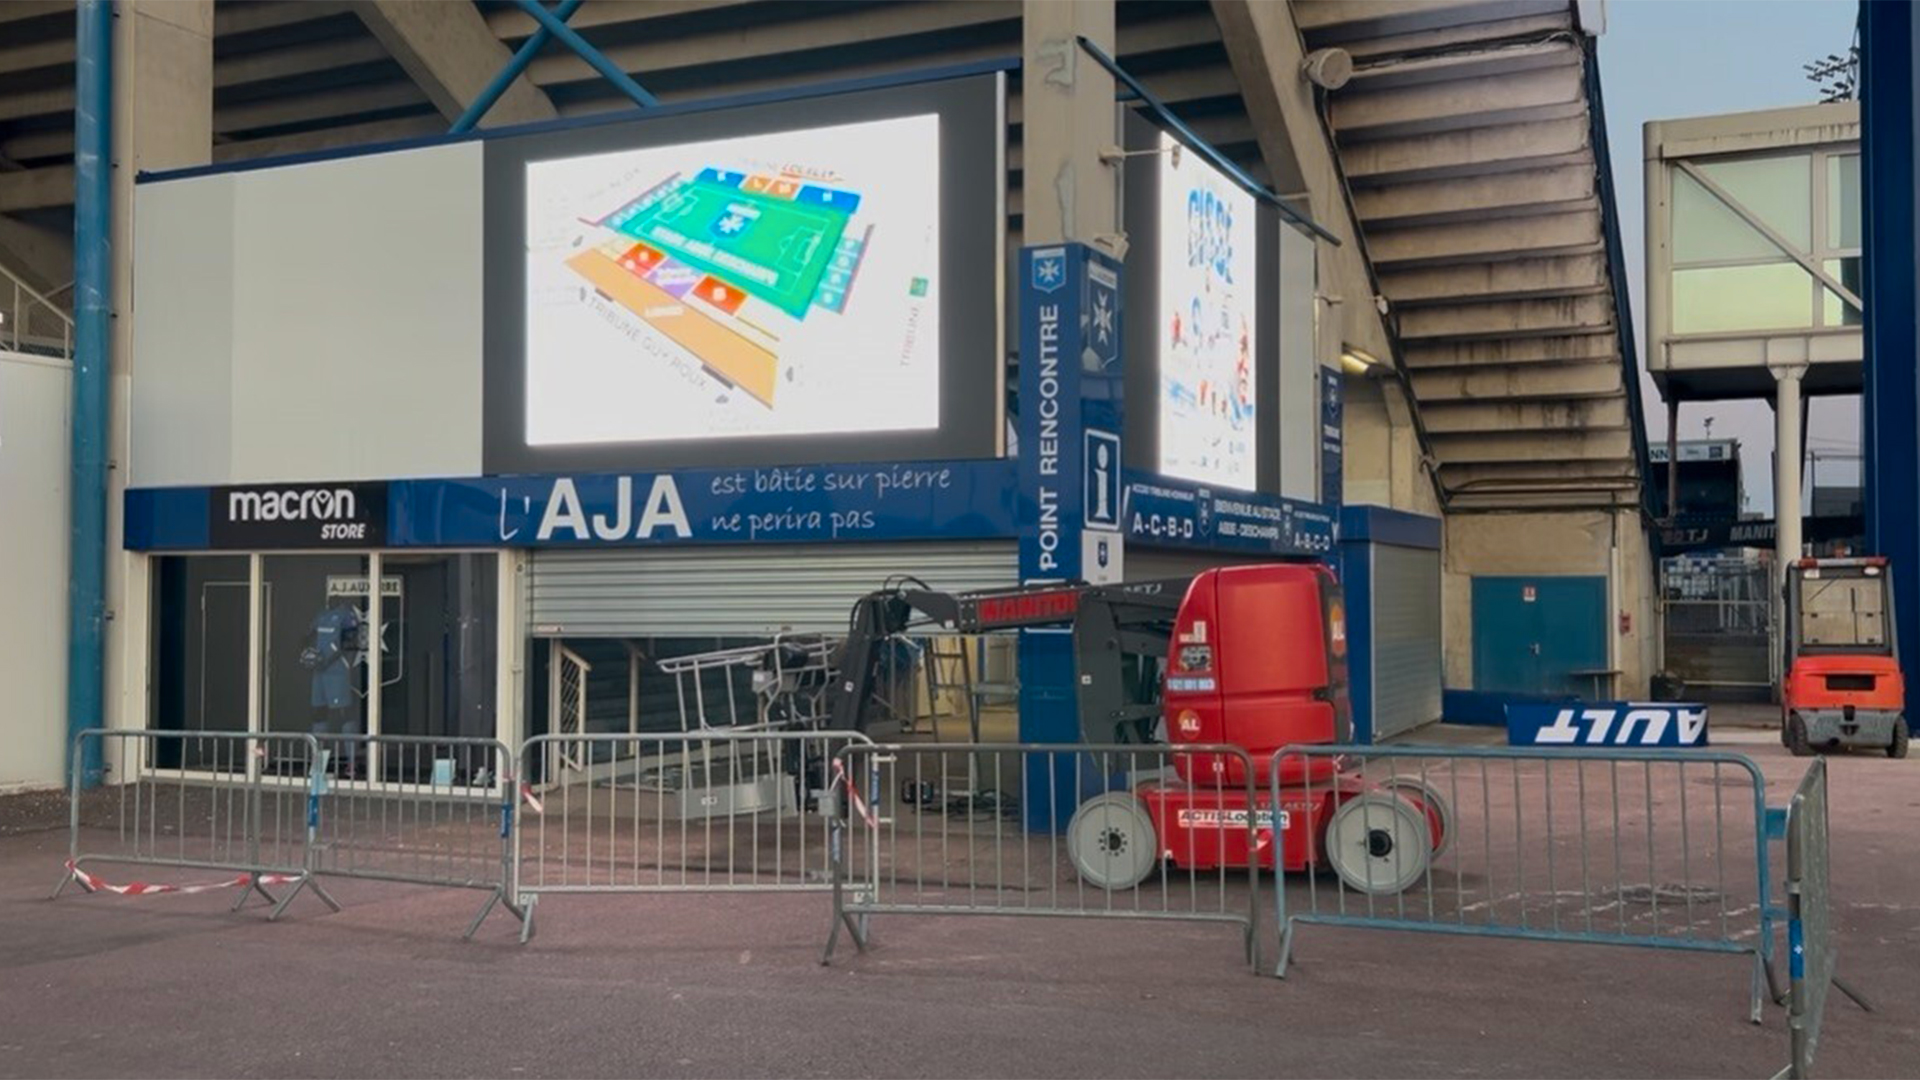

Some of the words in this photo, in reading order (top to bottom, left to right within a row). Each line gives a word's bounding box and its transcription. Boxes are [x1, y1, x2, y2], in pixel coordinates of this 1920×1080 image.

[587, 296, 641, 341] TRIBUNE
[1040, 304, 1058, 475] RENCONTRE
[711, 472, 746, 495] est
[754, 467, 816, 493] bâtie
[823, 472, 869, 491] sur
[875, 464, 950, 498] pierre
[229, 489, 355, 521] macron
[320, 523, 366, 539] STORE
[711, 513, 741, 532] ne
[749, 507, 822, 540] perira
[829, 510, 875, 539] pas
[1040, 487, 1058, 571] POINT
[1181, 718, 1200, 731] AL
